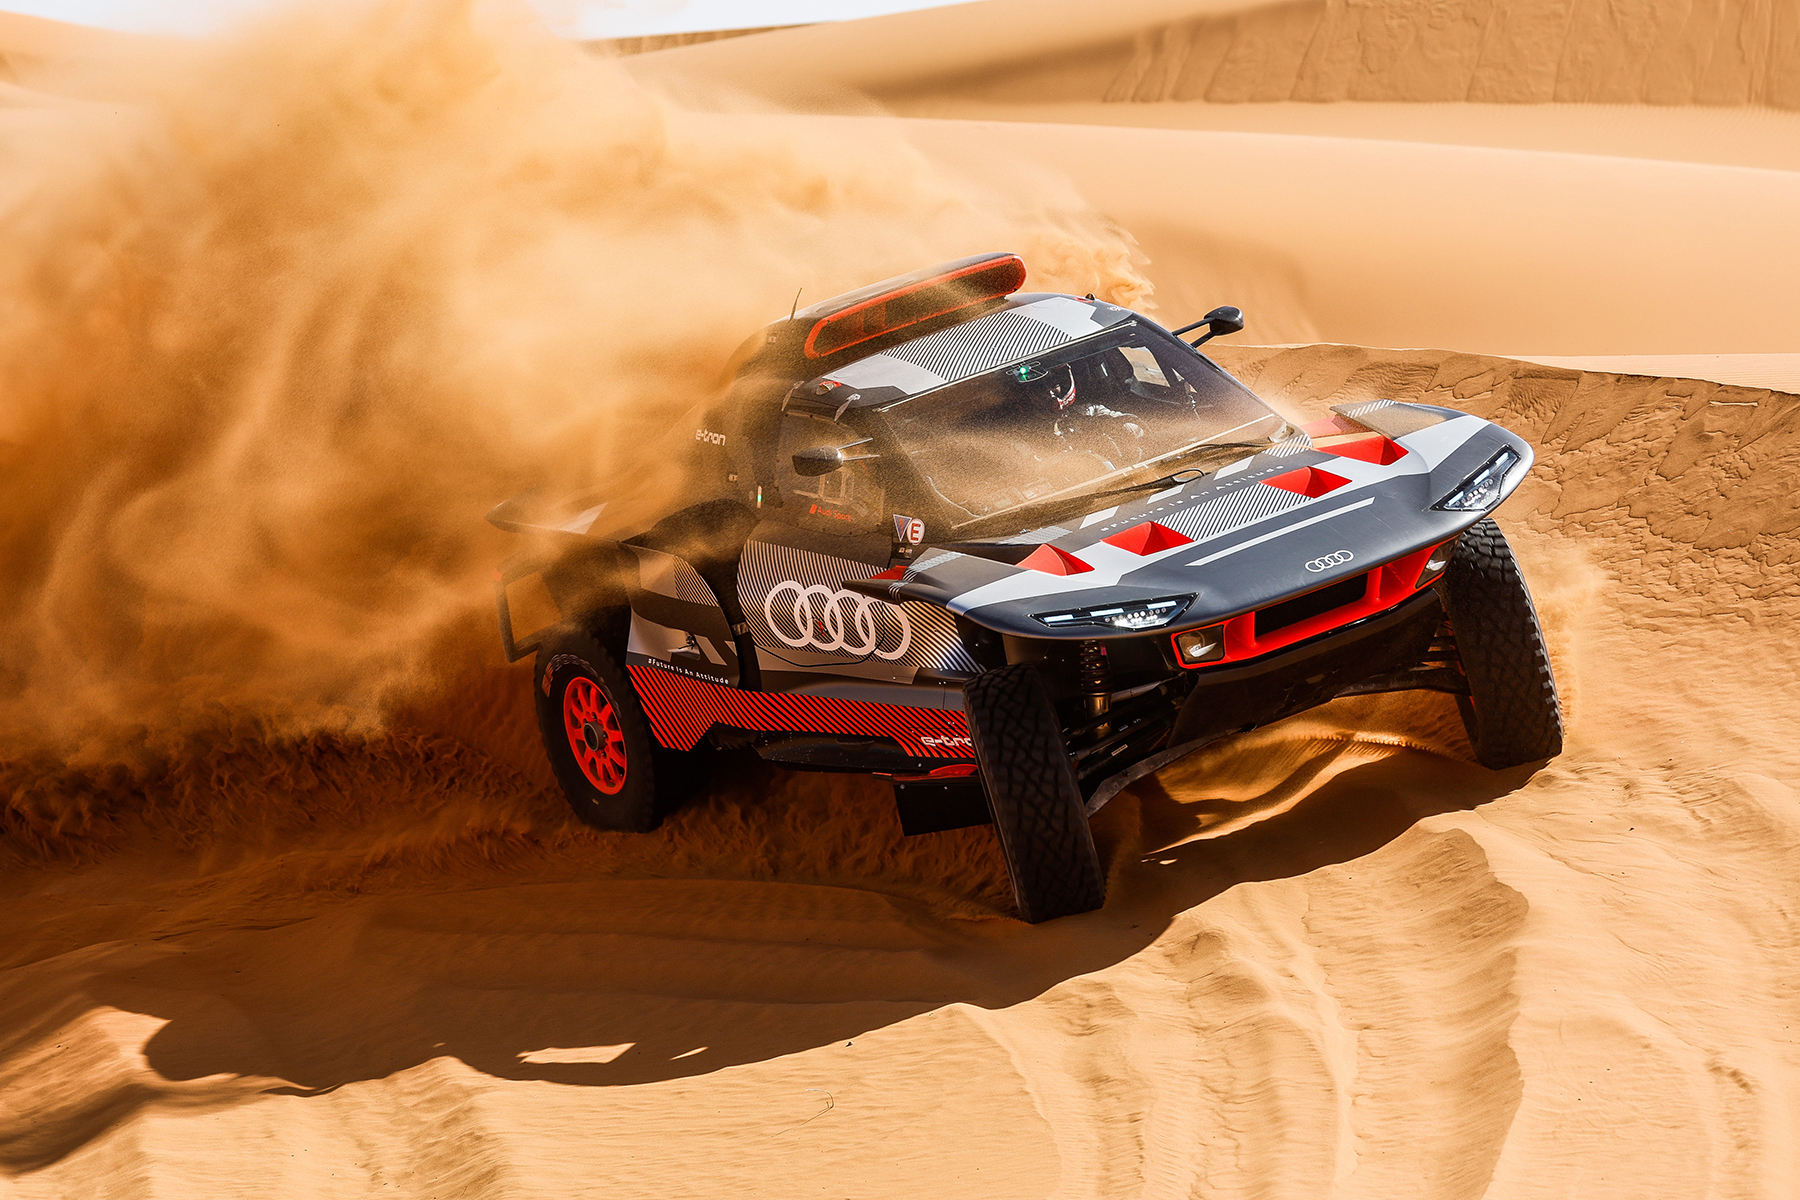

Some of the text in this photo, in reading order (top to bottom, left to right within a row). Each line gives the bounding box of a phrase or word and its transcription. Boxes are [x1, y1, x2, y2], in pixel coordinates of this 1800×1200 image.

[695, 428, 726, 446] e-tron
[1190, 491, 1210, 500] An
[1215, 465, 1285, 490] Attitude
[817, 506, 832, 517] Audi
[910, 522, 921, 541] E
[684, 668, 694, 677] An
[695, 671, 729, 685] Attitude
